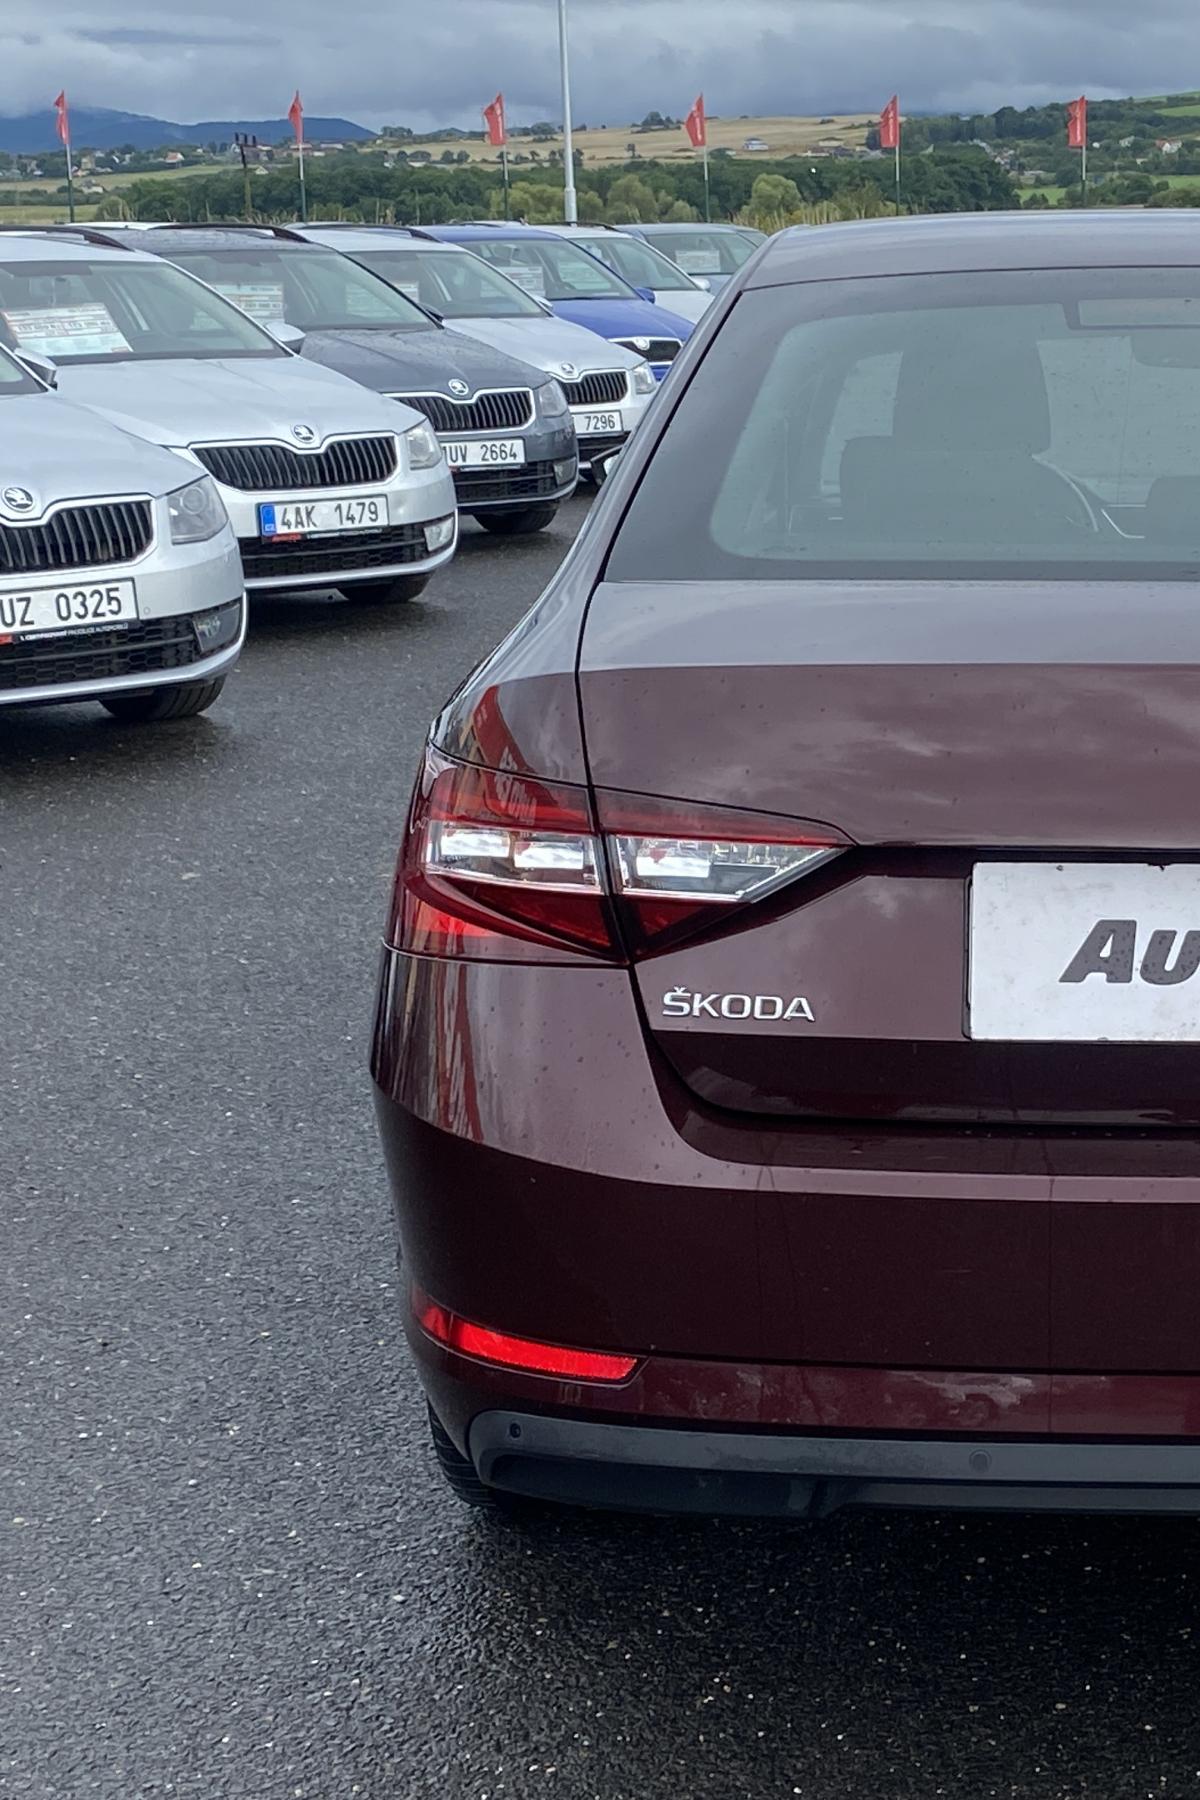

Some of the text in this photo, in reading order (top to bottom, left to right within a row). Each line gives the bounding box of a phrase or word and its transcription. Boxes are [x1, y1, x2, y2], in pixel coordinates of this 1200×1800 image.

[584, 414, 616, 431] 7296
[480, 443, 517, 462] 2664
[281, 501, 379, 530] 4AK 1479
[55, 587, 122, 622] 0325
[662, 986, 815, 1022] ŠKODA
